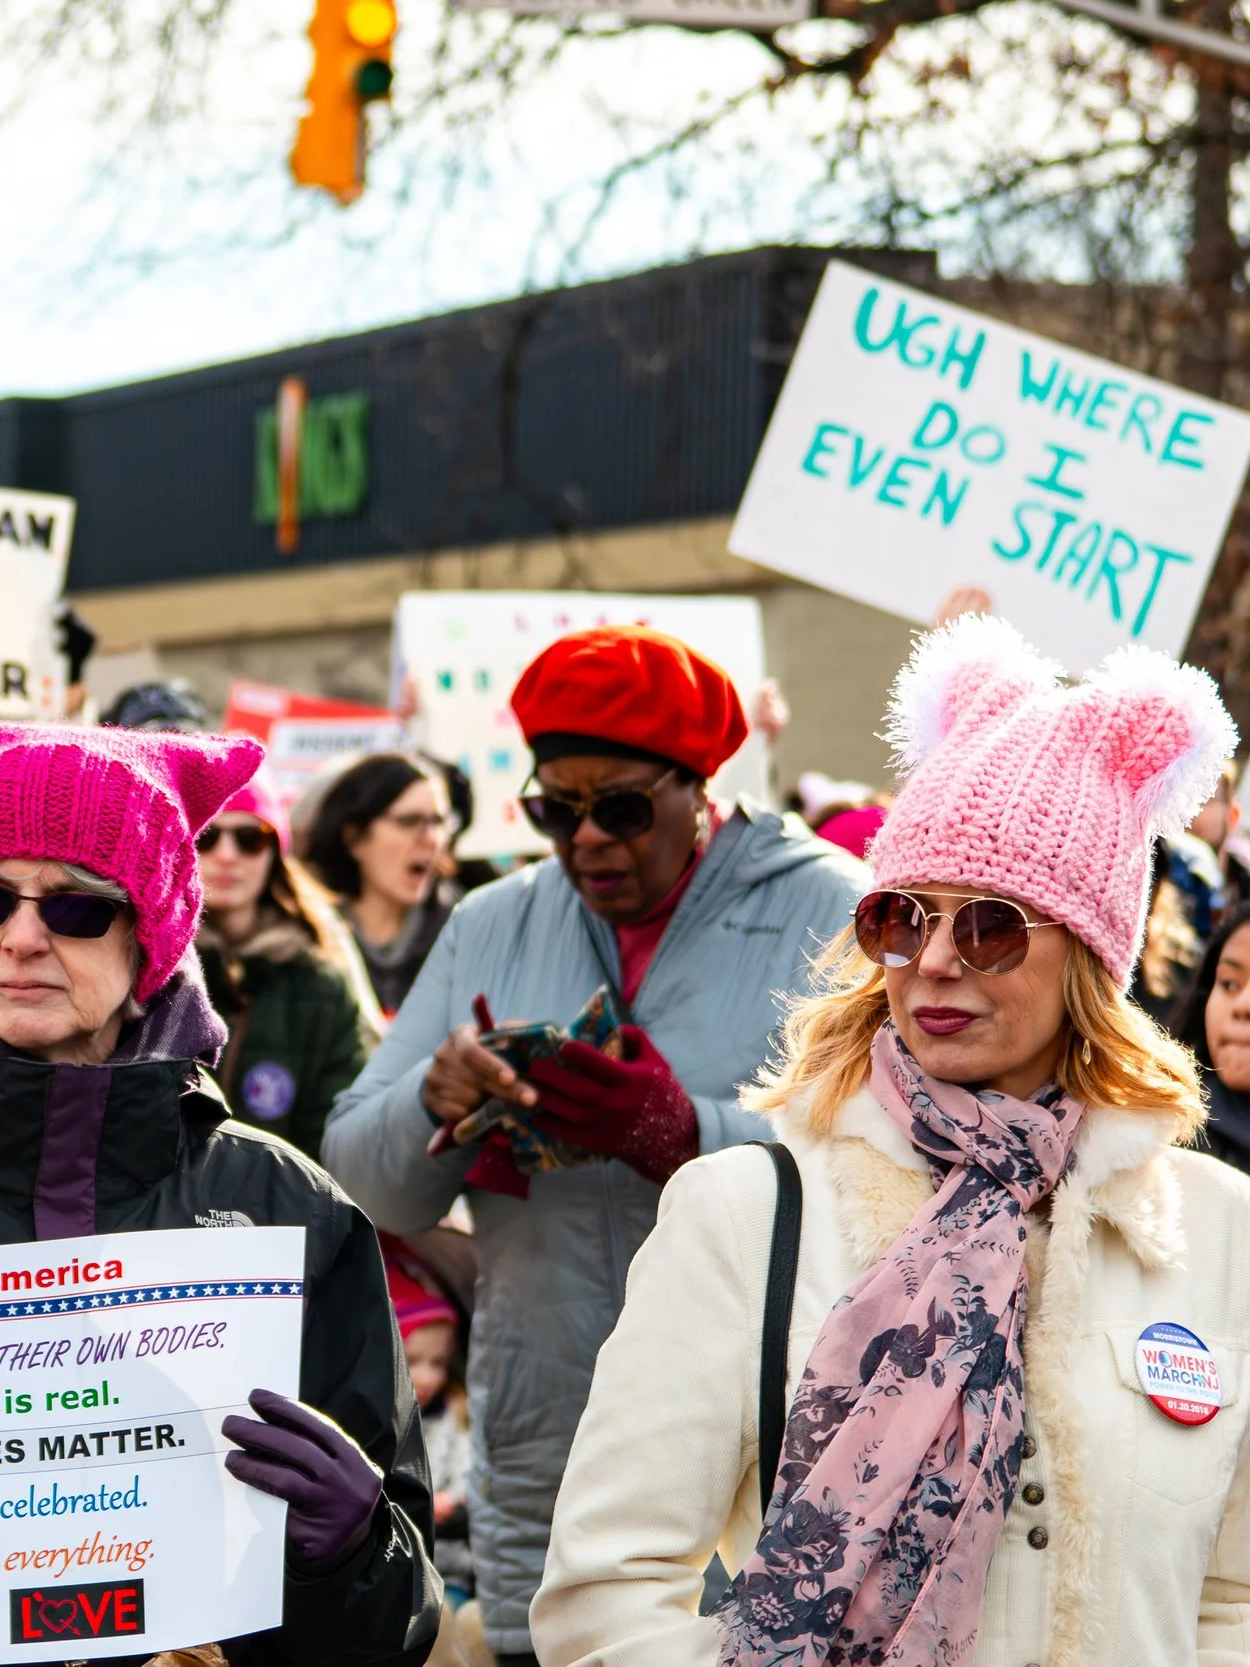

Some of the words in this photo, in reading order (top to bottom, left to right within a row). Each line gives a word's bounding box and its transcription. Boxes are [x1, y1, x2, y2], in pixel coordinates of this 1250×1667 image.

[854, 288, 986, 391] UGH
[1019, 349, 1216, 470] WHERE
[911, 401, 1007, 465] DO
[1024, 442, 1089, 501] I
[801, 422, 971, 527] EVEN
[991, 500, 1194, 638] START
[208, 1209, 232, 1220] THE
[76, 1330, 132, 1365] OWN
[135, 1321, 227, 1358] BODIES.
[1152, 1332, 1198, 1346] MORRISTOWN
[1142, 1349, 1217, 1375] WOMEN'S
[4, 1389, 32, 1414] is
[46, 1380, 120, 1411] real.
[38, 1423, 186, 1461] MATTER.
[0, 1475, 148, 1519] celebrated.
[3, 1531, 155, 1578] everything.
